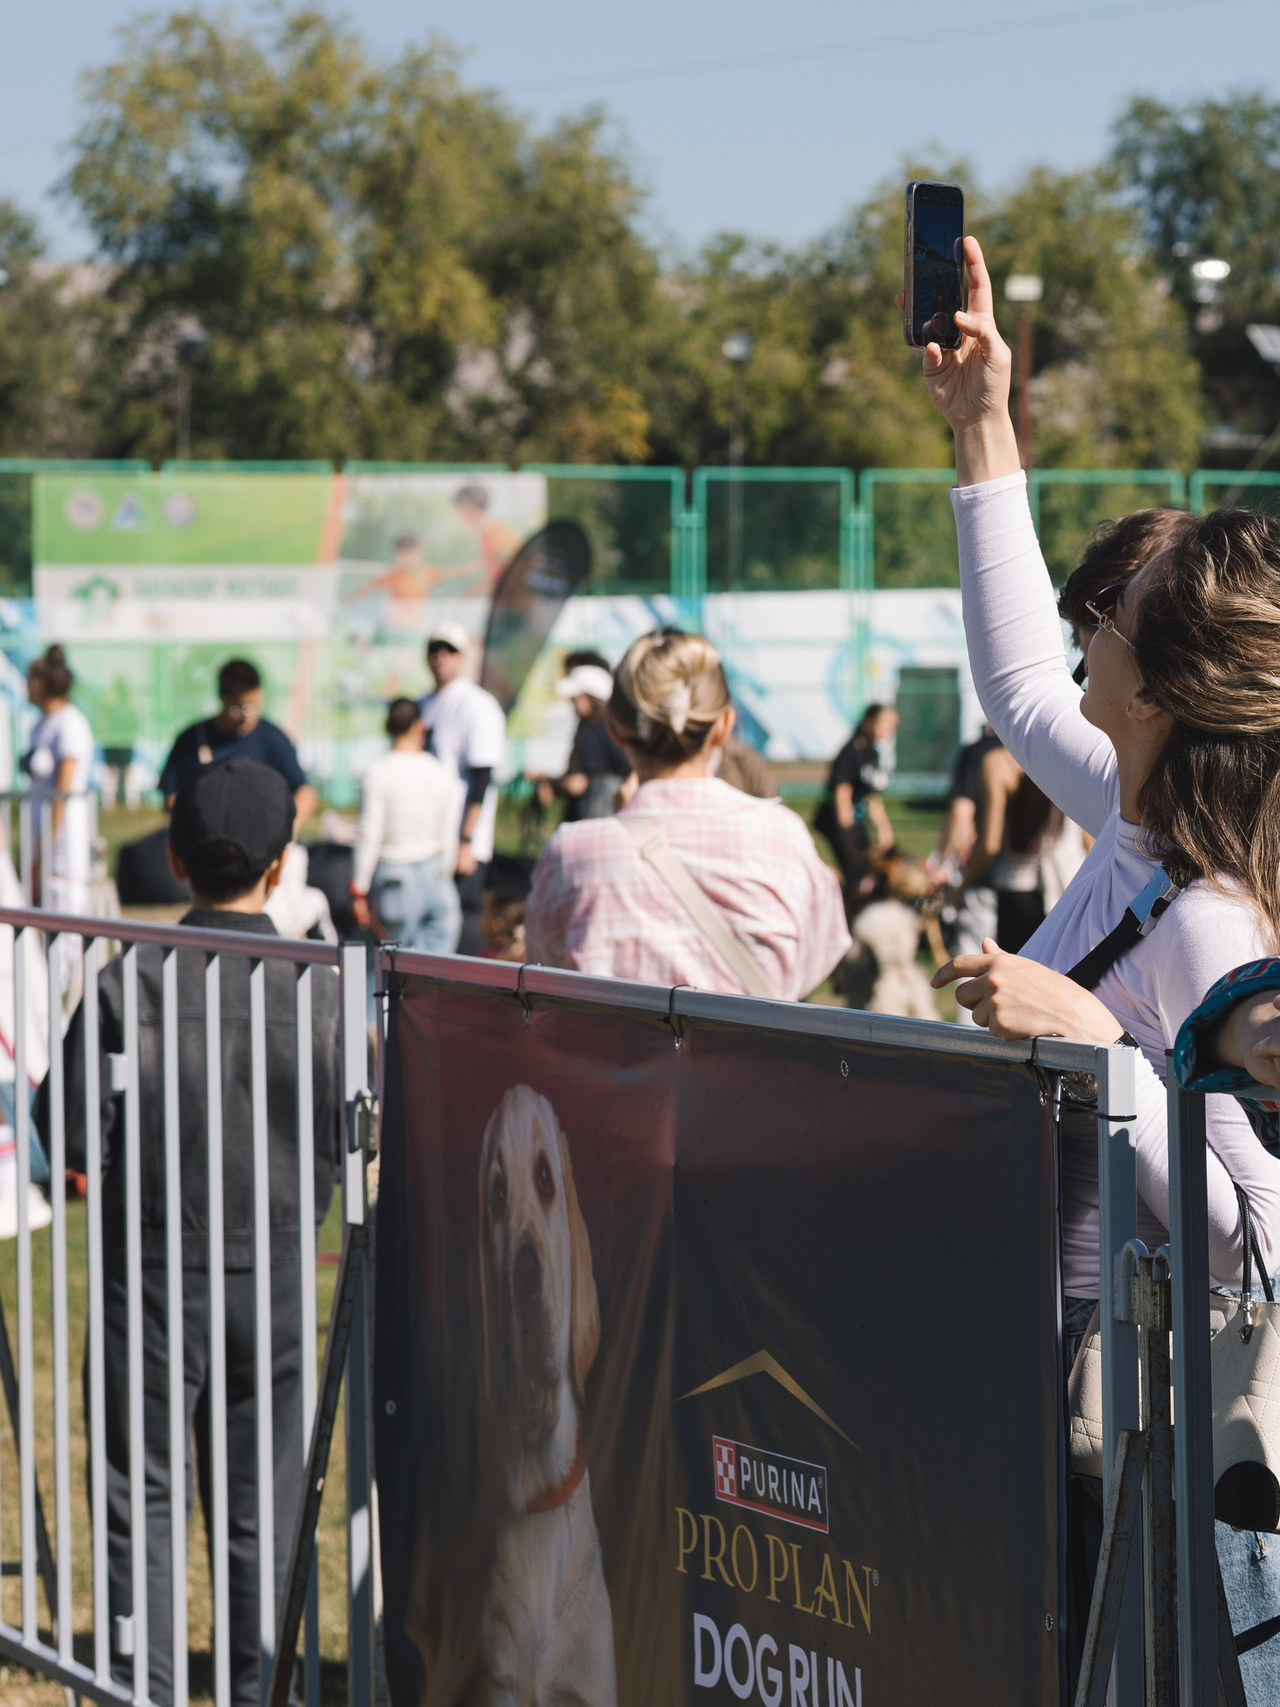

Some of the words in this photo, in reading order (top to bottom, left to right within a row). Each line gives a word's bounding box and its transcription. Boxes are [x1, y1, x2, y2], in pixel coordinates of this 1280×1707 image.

[675, 1507, 758, 1593] PRO
[693, 1612, 783, 1707] DOG
[788, 1643, 862, 1707] RUN
